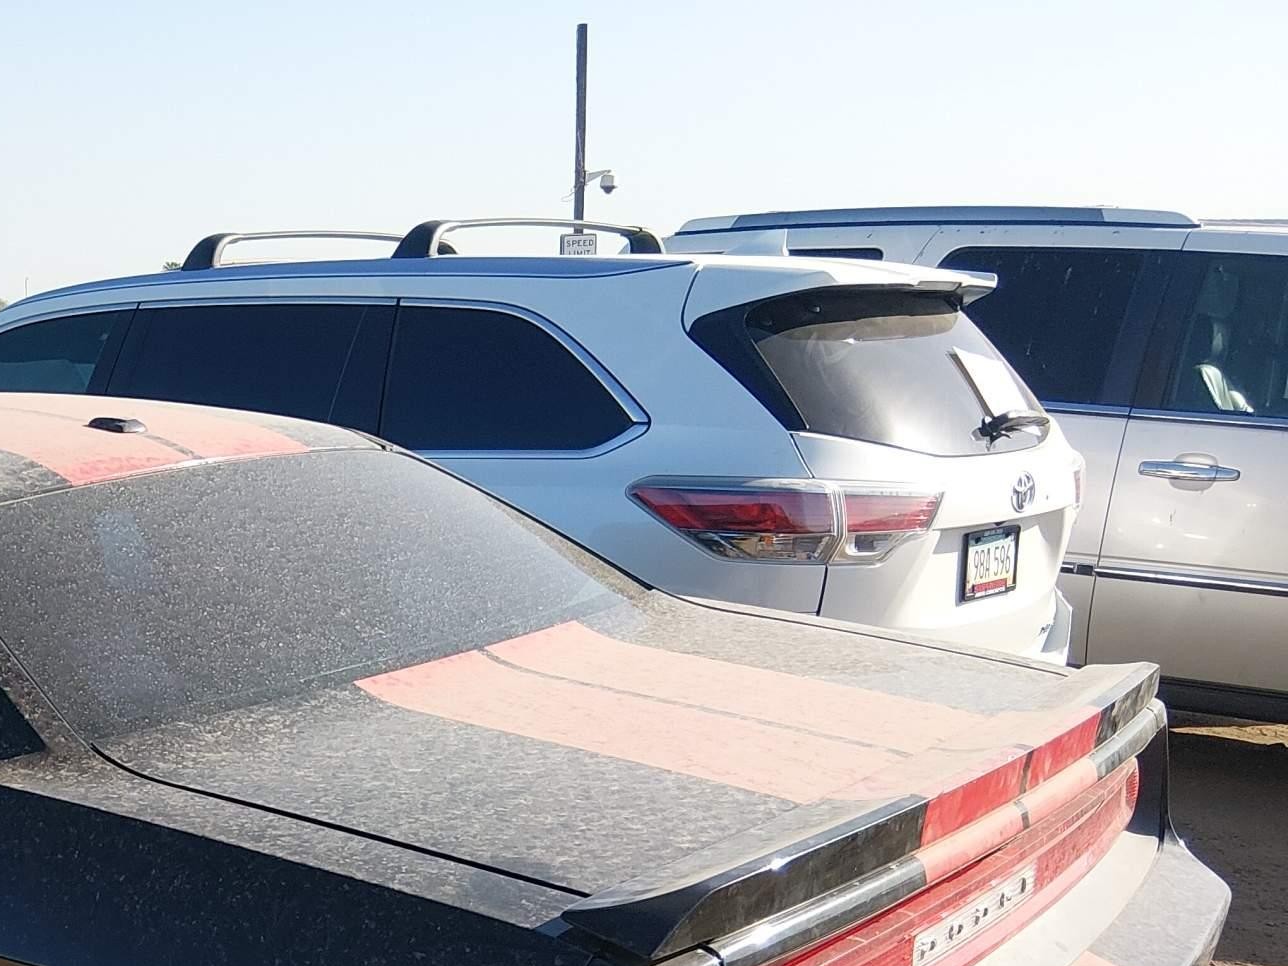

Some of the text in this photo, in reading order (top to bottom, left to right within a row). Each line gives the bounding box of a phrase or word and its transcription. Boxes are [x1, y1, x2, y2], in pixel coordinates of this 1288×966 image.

[566, 239, 594, 247] SPEED
[973, 544, 1011, 581] 98A 596
